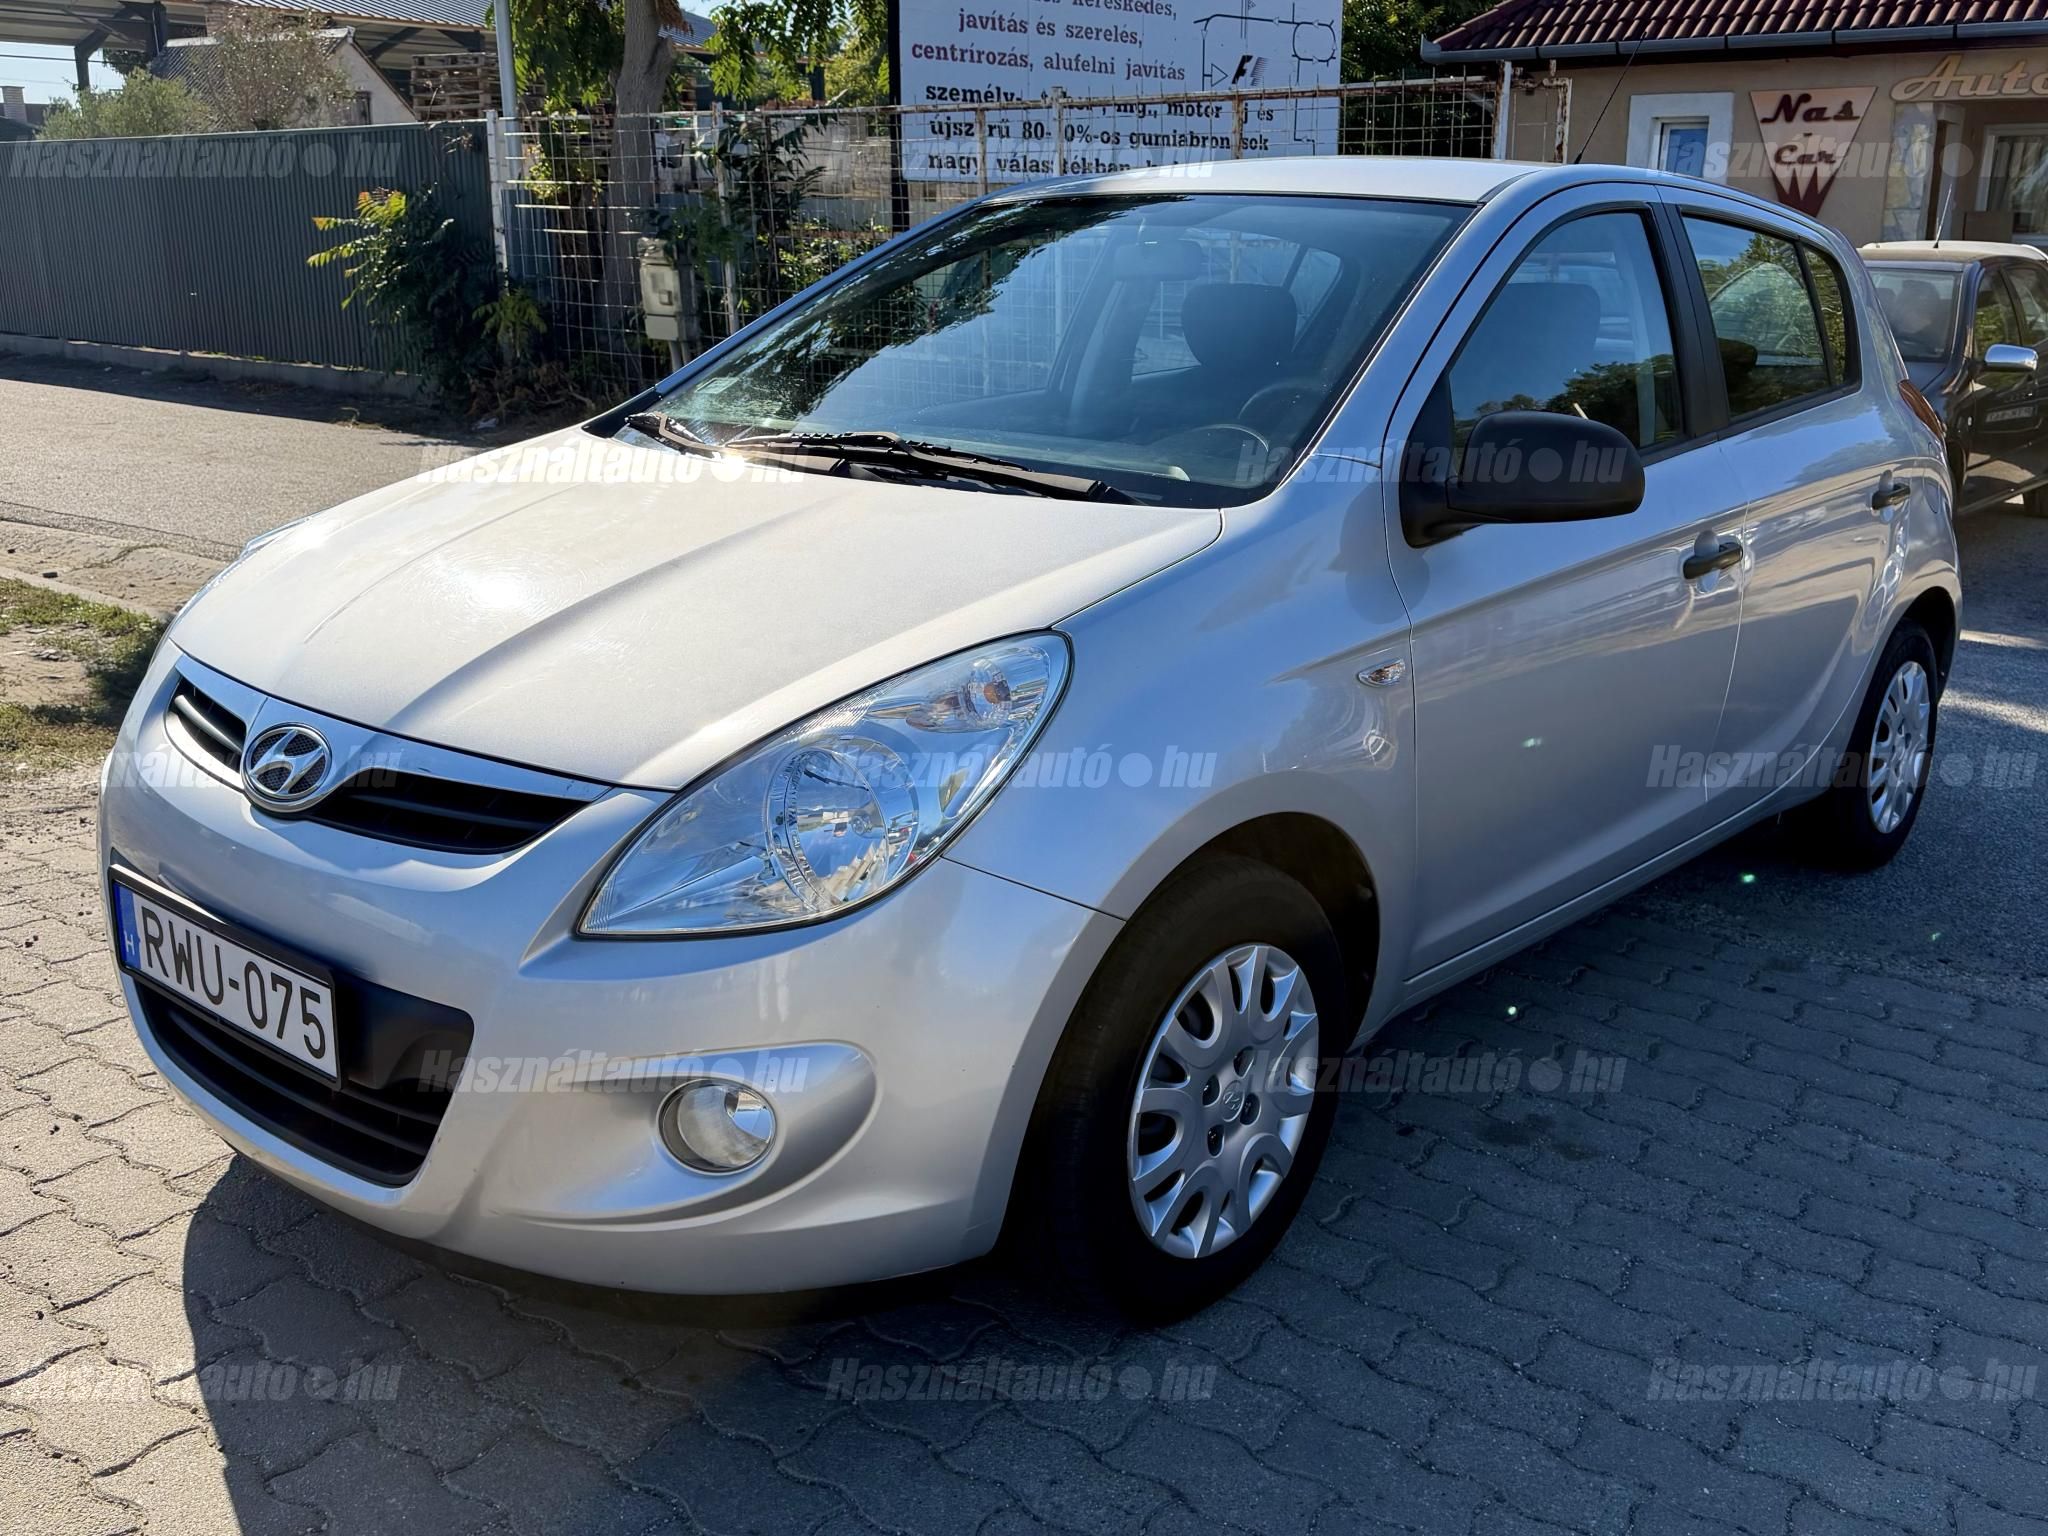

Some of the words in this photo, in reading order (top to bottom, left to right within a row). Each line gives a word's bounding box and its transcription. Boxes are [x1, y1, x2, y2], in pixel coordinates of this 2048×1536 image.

[958, 8, 1029, 34] javítás
[1036, 15, 1056, 36] és
[1065, 24, 1142, 48] szerelés,
[912, 42, 1034, 72] centrírozás,
[1044, 52, 1115, 75] alufelni
[1125, 60, 1186, 81] javítás
[1760, 93, 1860, 123] Nas
[929, 113, 1011, 140] újszrű
[1022, 120, 1121, 146] 80-0%-os
[1129, 129, 1269, 152] gumiabronsok
[997, 151, 1132, 175] válastékban
[1774, 145, 1837, 165] Car
[124, 932, 137, 956] H
[141, 905, 326, 1060] RWU-075
